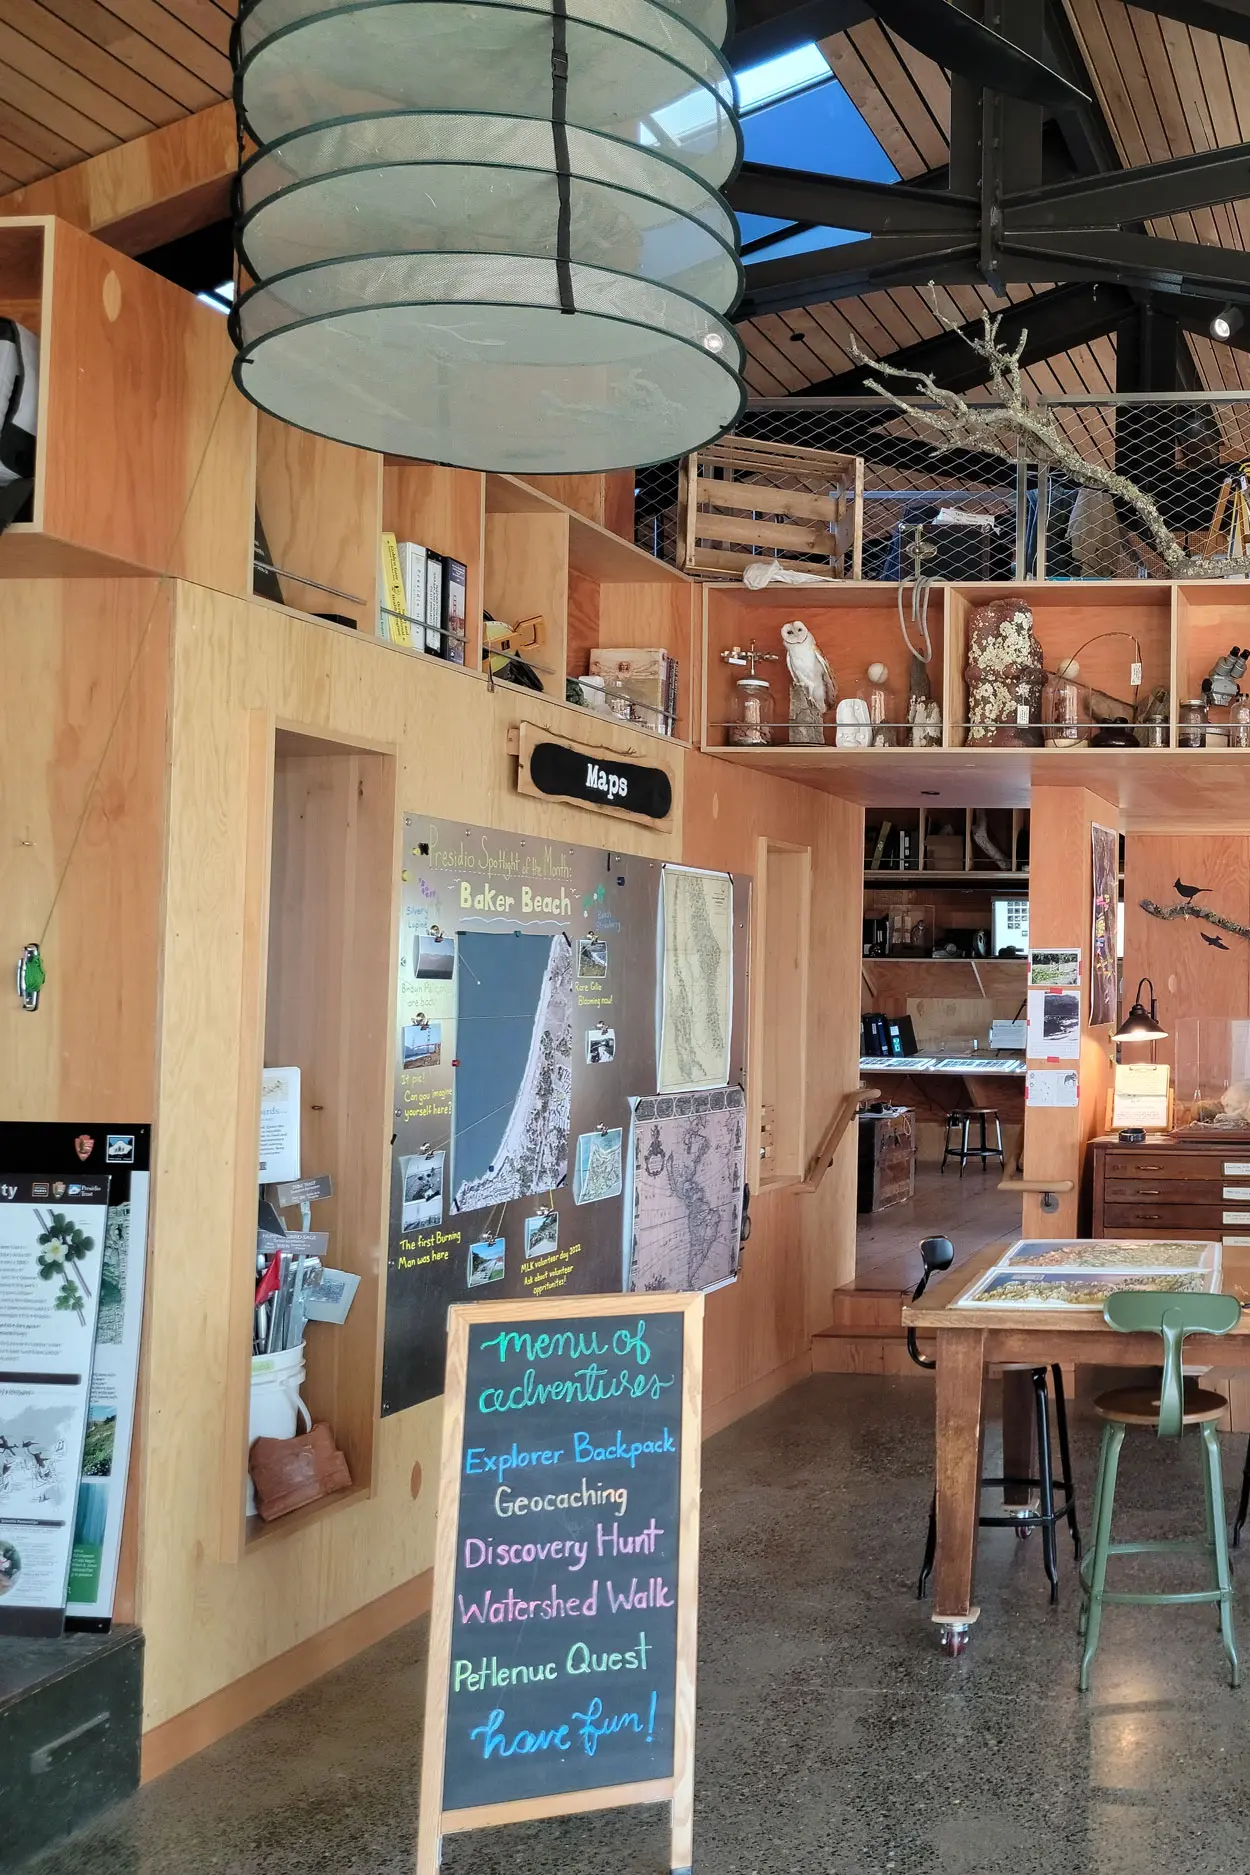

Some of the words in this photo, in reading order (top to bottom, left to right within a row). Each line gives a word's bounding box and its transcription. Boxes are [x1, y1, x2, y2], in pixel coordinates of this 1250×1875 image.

[585, 763, 628, 800] Maps
[428, 824, 475, 869] Presidio
[479, 834, 520, 880] Spotlight
[522, 852, 533, 877] of
[531, 853, 545, 875] the
[544, 846, 573, 878] Month:
[459, 881, 515, 912] Baker
[520, 886, 572, 916] Beach
[404, 1089, 419, 1103] Can
[418, 1092, 431, 1105] you
[431, 1087, 453, 1099] imagine
[404, 1104, 433, 1122] yourself
[432, 1101, 453, 1115] here?
[398, 1255, 416, 1269] Man
[417, 1255, 431, 1266] was
[431, 1250, 449, 1262] here
[400, 1238, 415, 1251] The
[417, 1232, 436, 1248] first
[435, 1230, 461, 1245] Burning
[521, 1260, 535, 1273] MLK
[534, 1253, 560, 1268] volunteer
[560, 1250, 569, 1262] day
[523, 1275, 534, 1286] Ask
[534, 1270, 548, 1282] about
[549, 1265, 574, 1278] volunteer
[480, 1327, 608, 1362] menu
[612, 1319, 652, 1365] of
[478, 1363, 676, 1414] adventures
[465, 1443, 565, 1483] Explorer
[572, 1427, 677, 1470] Backpack
[493, 1477, 628, 1518] Geocaching
[464, 1535, 588, 1571] Discovery
[596, 1518, 664, 1559] Hunt
[457, 1579, 599, 1625] Watershed
[606, 1577, 674, 1613] Walk
[453, 1655, 558, 1692] Petlenuc
[566, 1631, 653, 1676] Quest
[469, 1707, 571, 1760] have
[571, 1690, 659, 1757] fun!
